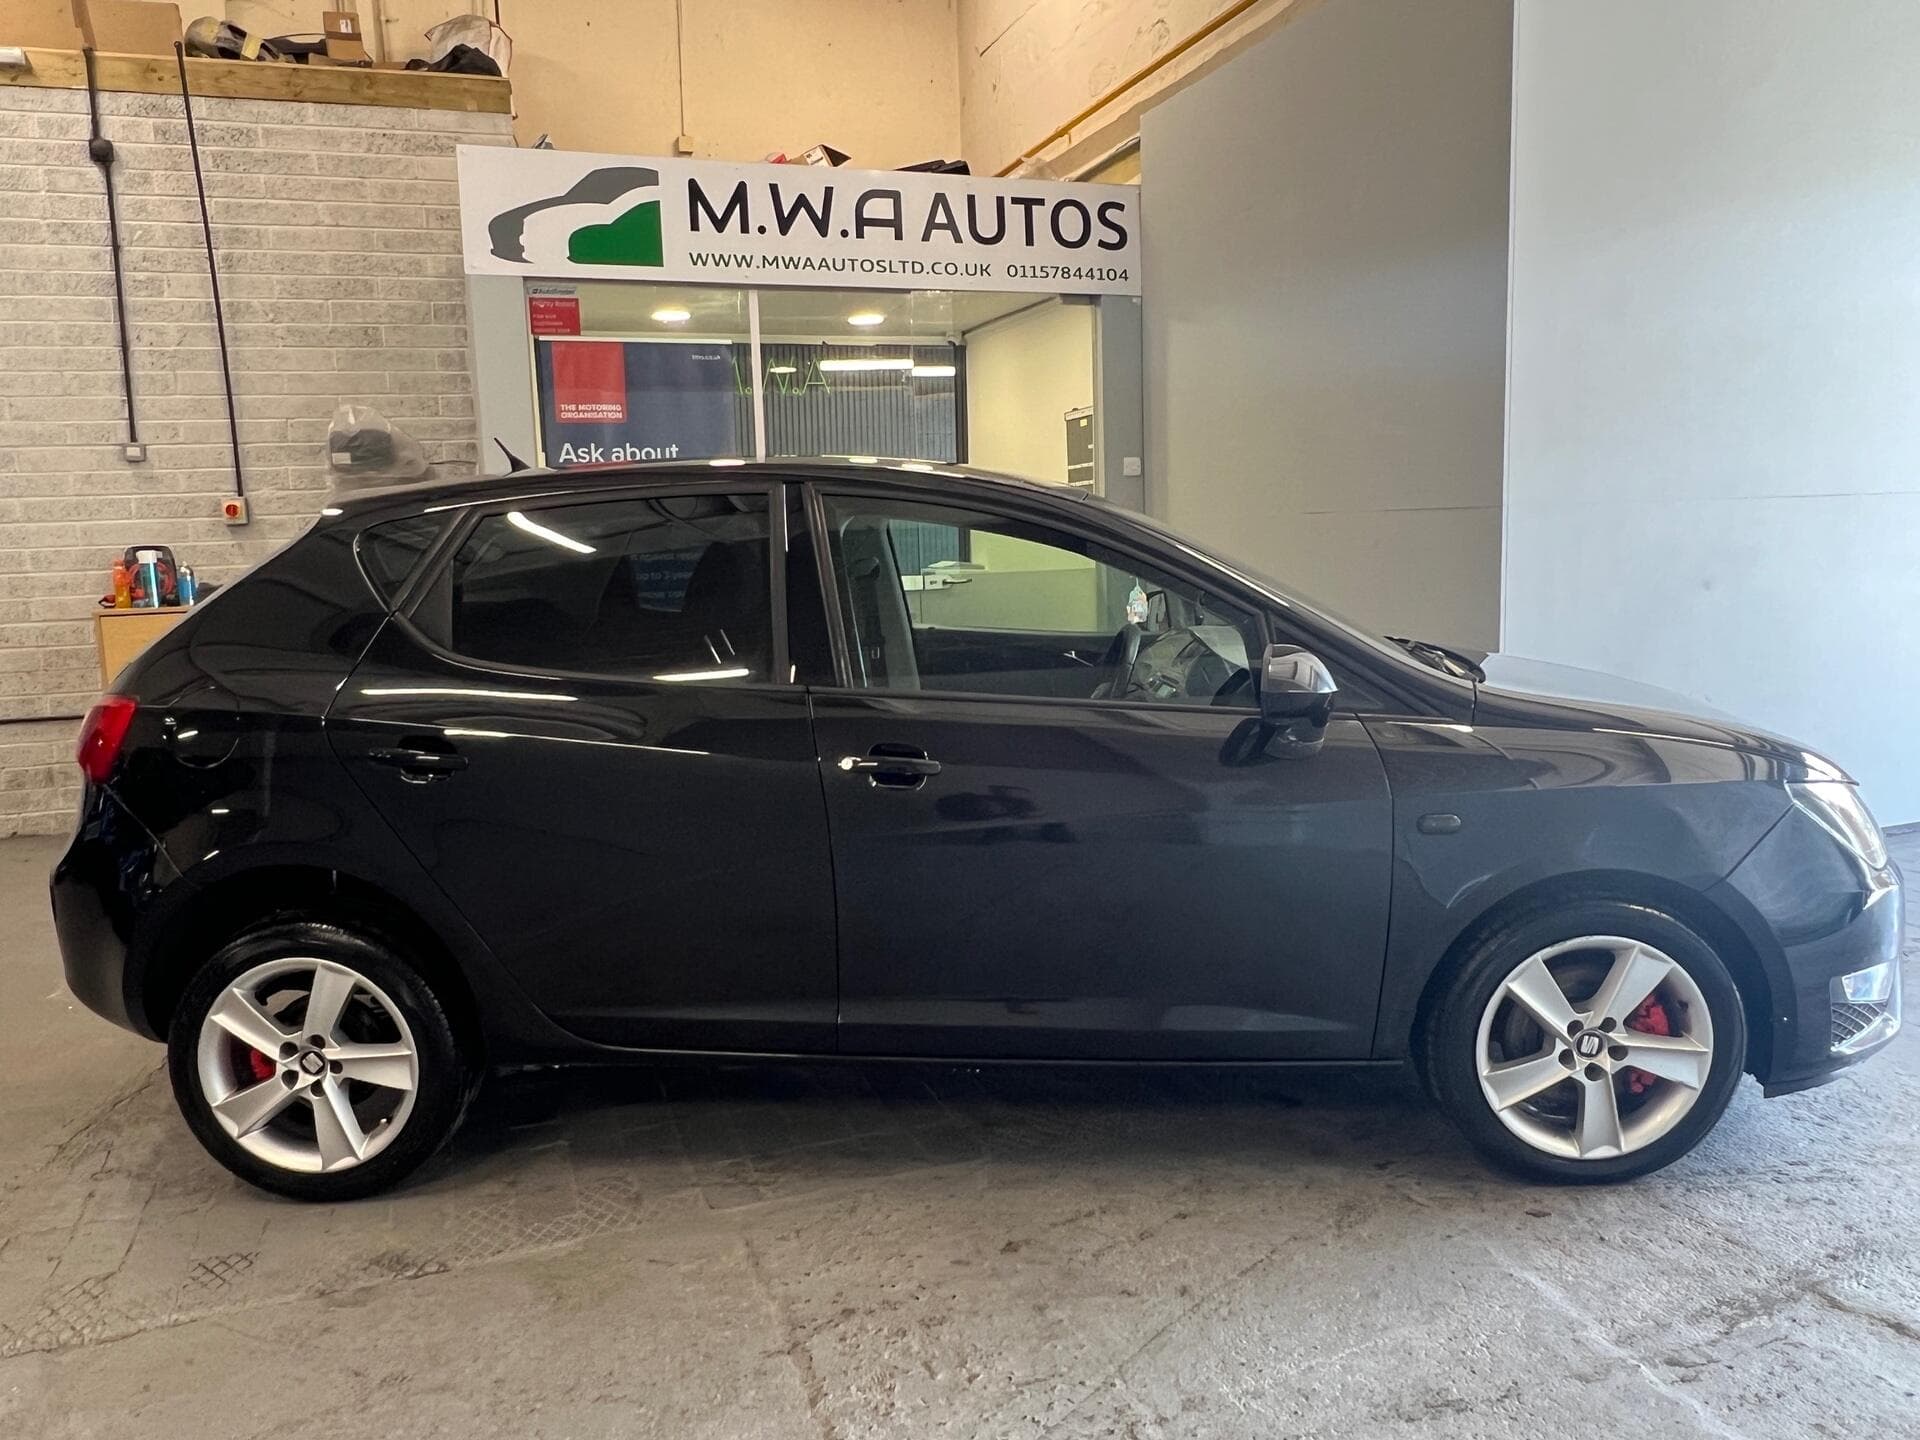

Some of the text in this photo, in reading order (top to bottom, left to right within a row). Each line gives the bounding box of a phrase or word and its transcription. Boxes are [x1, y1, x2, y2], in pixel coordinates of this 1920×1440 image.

[688, 178, 1128, 251] M.W.A AUTOS
[689, 252, 1129, 282] WWW.MWAAUTOSLTD.CO.UK 01157844104
[560, 404, 622, 412] THE MOTORING
[560, 411, 623, 419] ORGANISATION
[559, 442, 679, 463] Ask about
